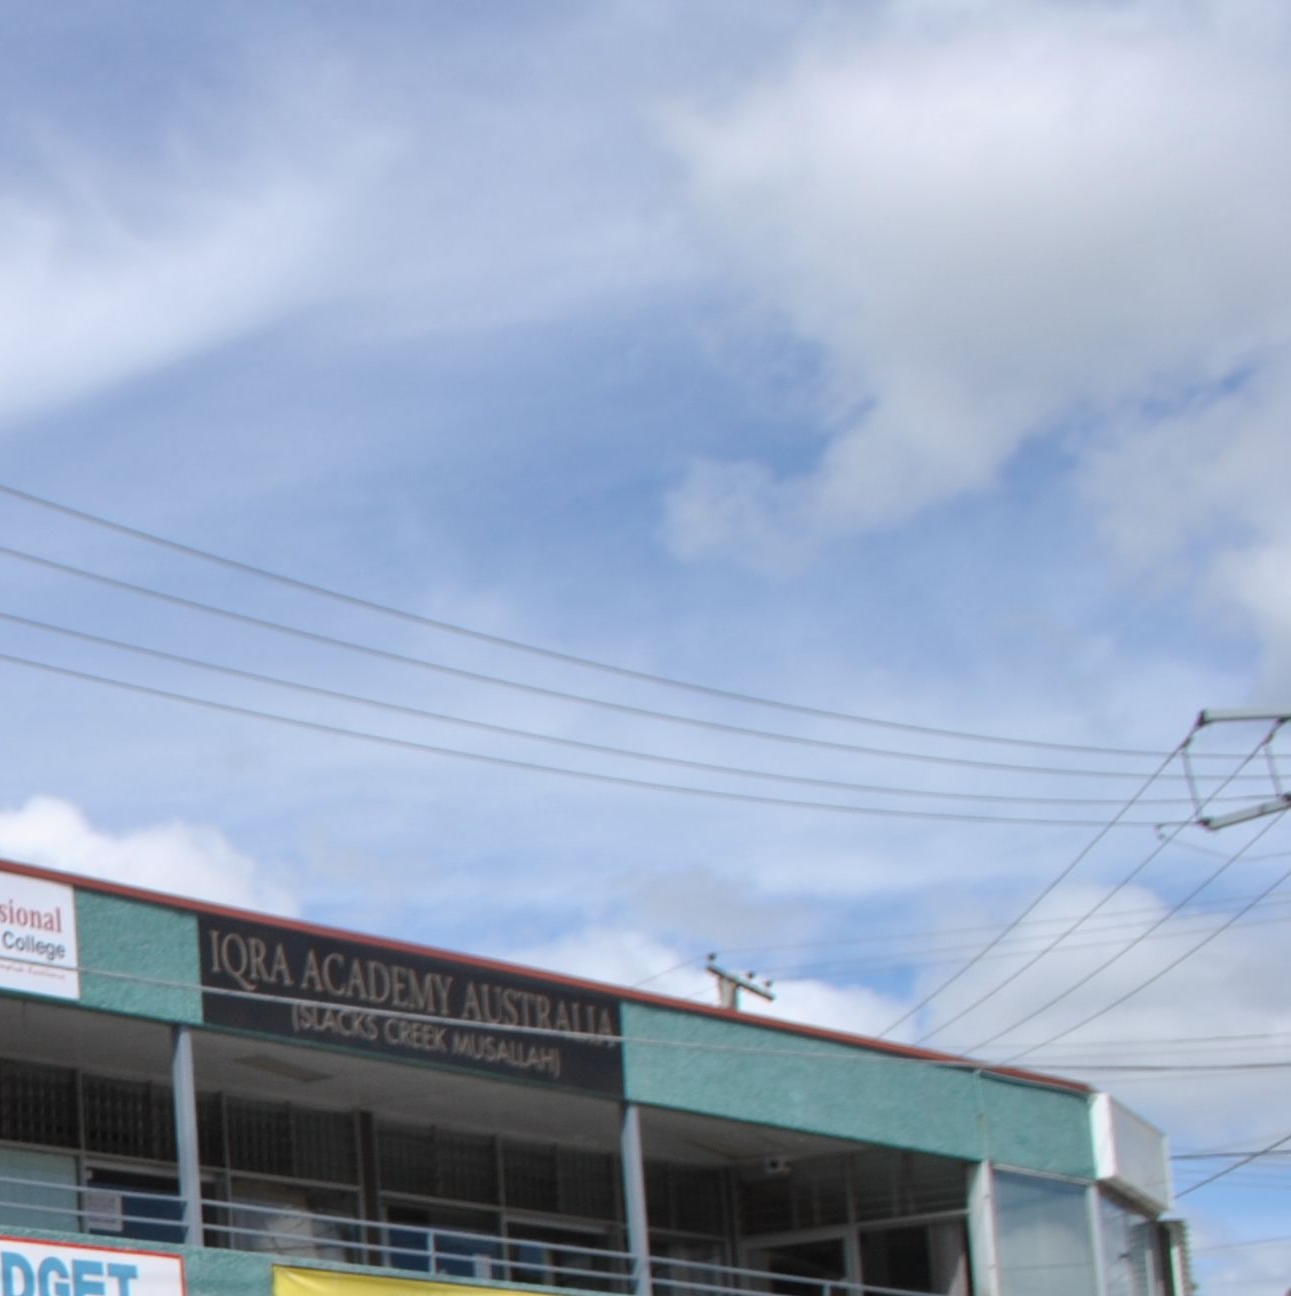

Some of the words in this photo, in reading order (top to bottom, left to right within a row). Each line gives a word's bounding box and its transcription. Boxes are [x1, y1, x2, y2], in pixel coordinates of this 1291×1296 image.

[2, 931, 65, 961] College
[209, 930, 294, 991] IQRA
[300, 949, 453, 1016] ACADEMY
[461, 981, 617, 1048] AUSTRALIA
[292, 1003, 378, 1040] (SLACKS
[384, 1017, 447, 1051] CREEK
[453, 1031, 561, 1079] MUSALLAH)
